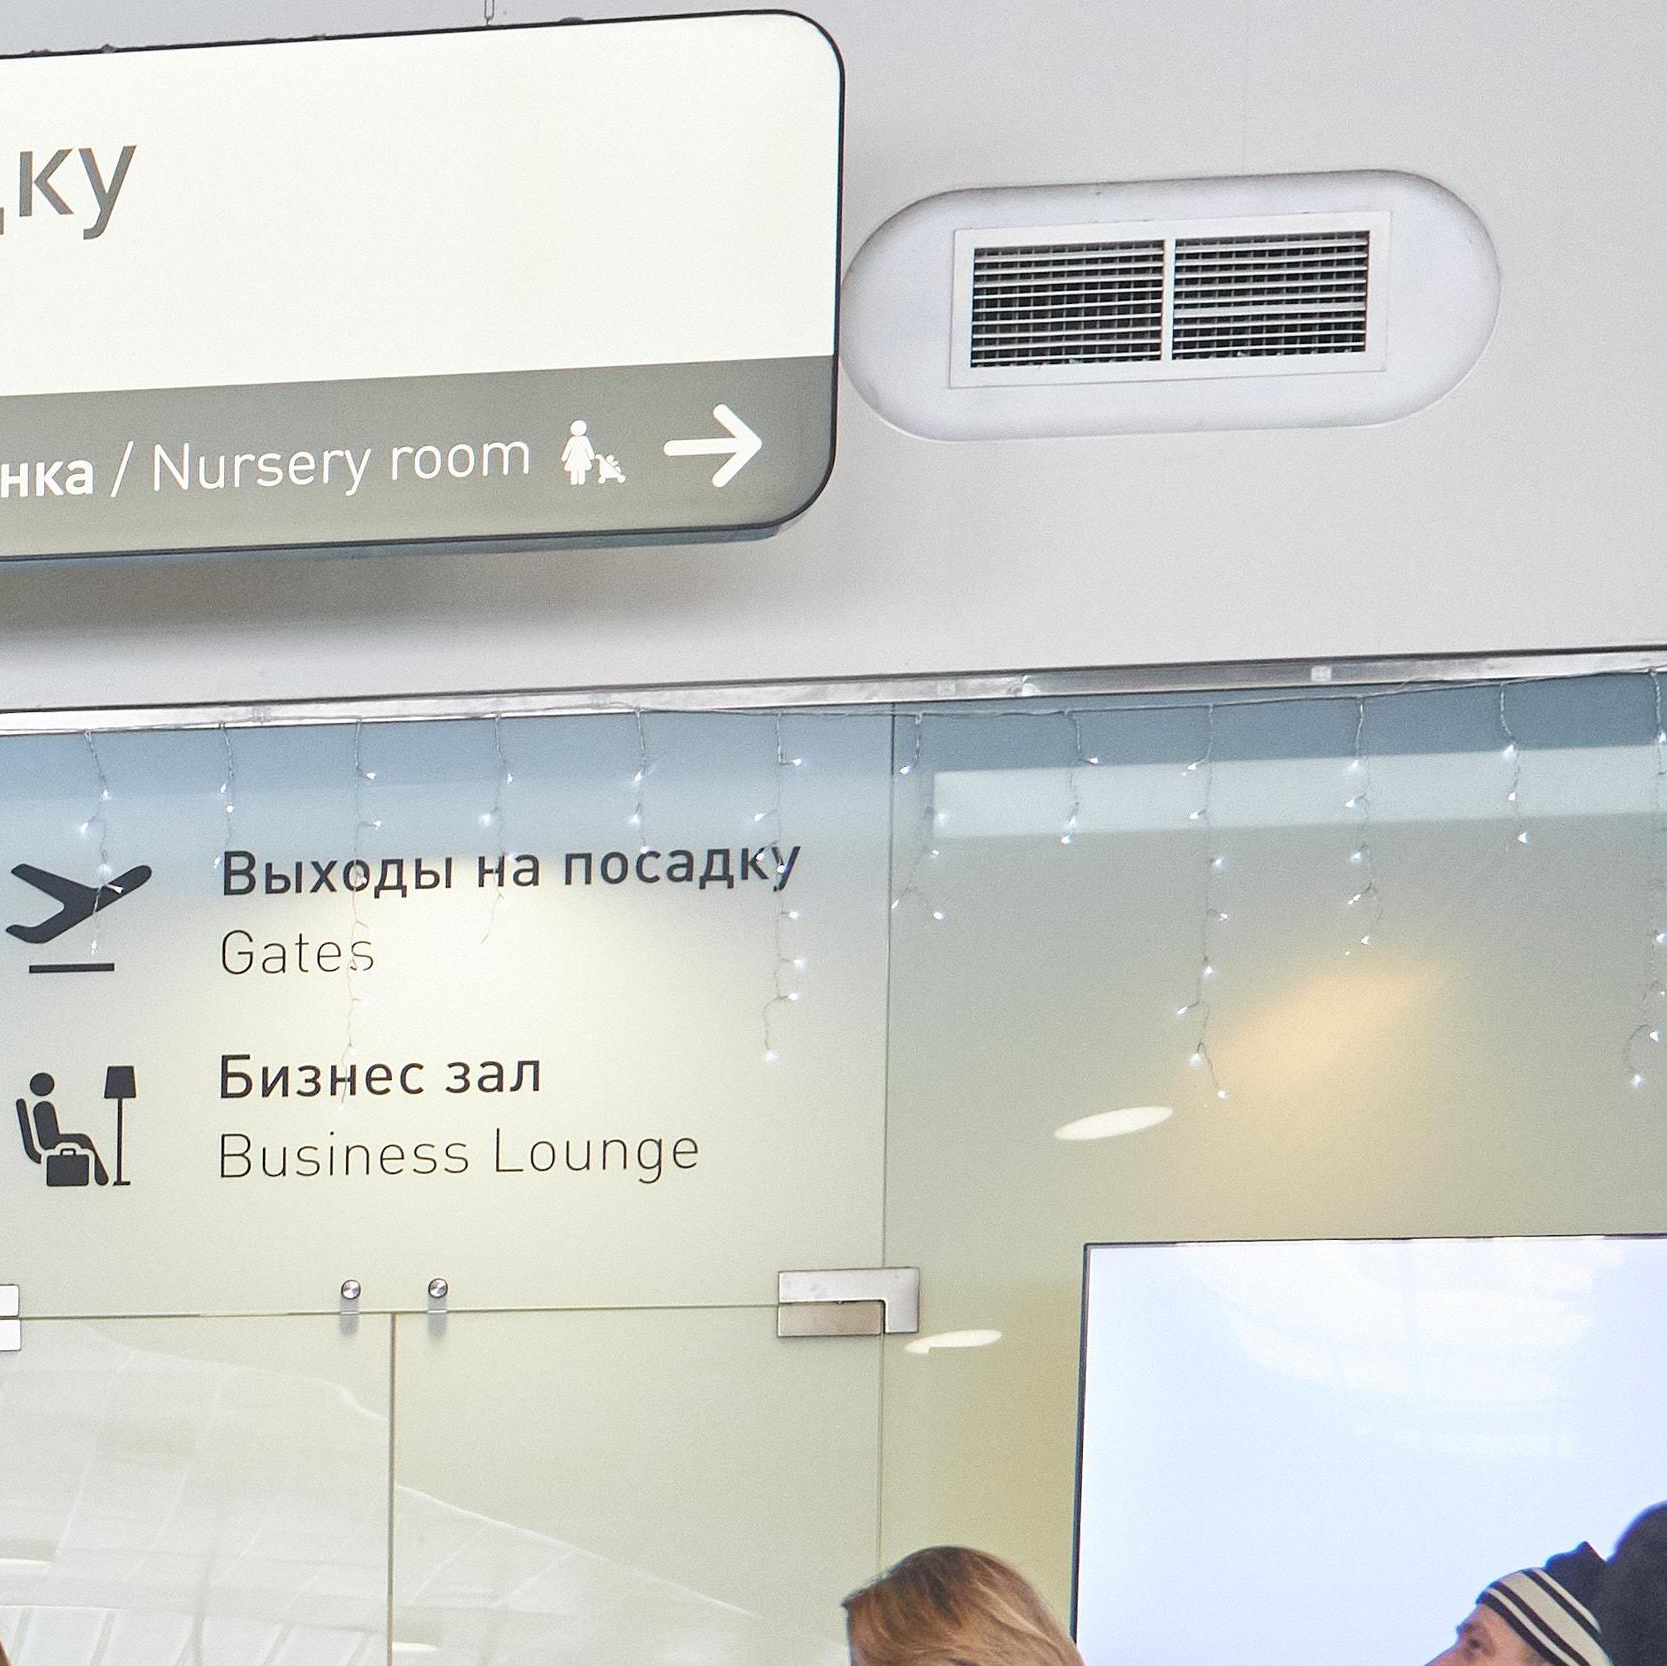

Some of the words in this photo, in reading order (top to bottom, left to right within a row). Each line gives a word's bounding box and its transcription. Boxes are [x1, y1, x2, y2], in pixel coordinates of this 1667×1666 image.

[152, 440, 366, 498] Nursery
[390, 434, 530, 481] room
[221, 850, 452, 901] Выходы
[476, 852, 541, 890] на
[563, 842, 800, 892] посадку
[221, 930, 375, 976] Gates
[219, 1053, 425, 1100] Бизнес
[446, 1055, 542, 1094] зал
[219, 1131, 470, 1180] Business
[493, 1127, 701, 1186] Lounge
